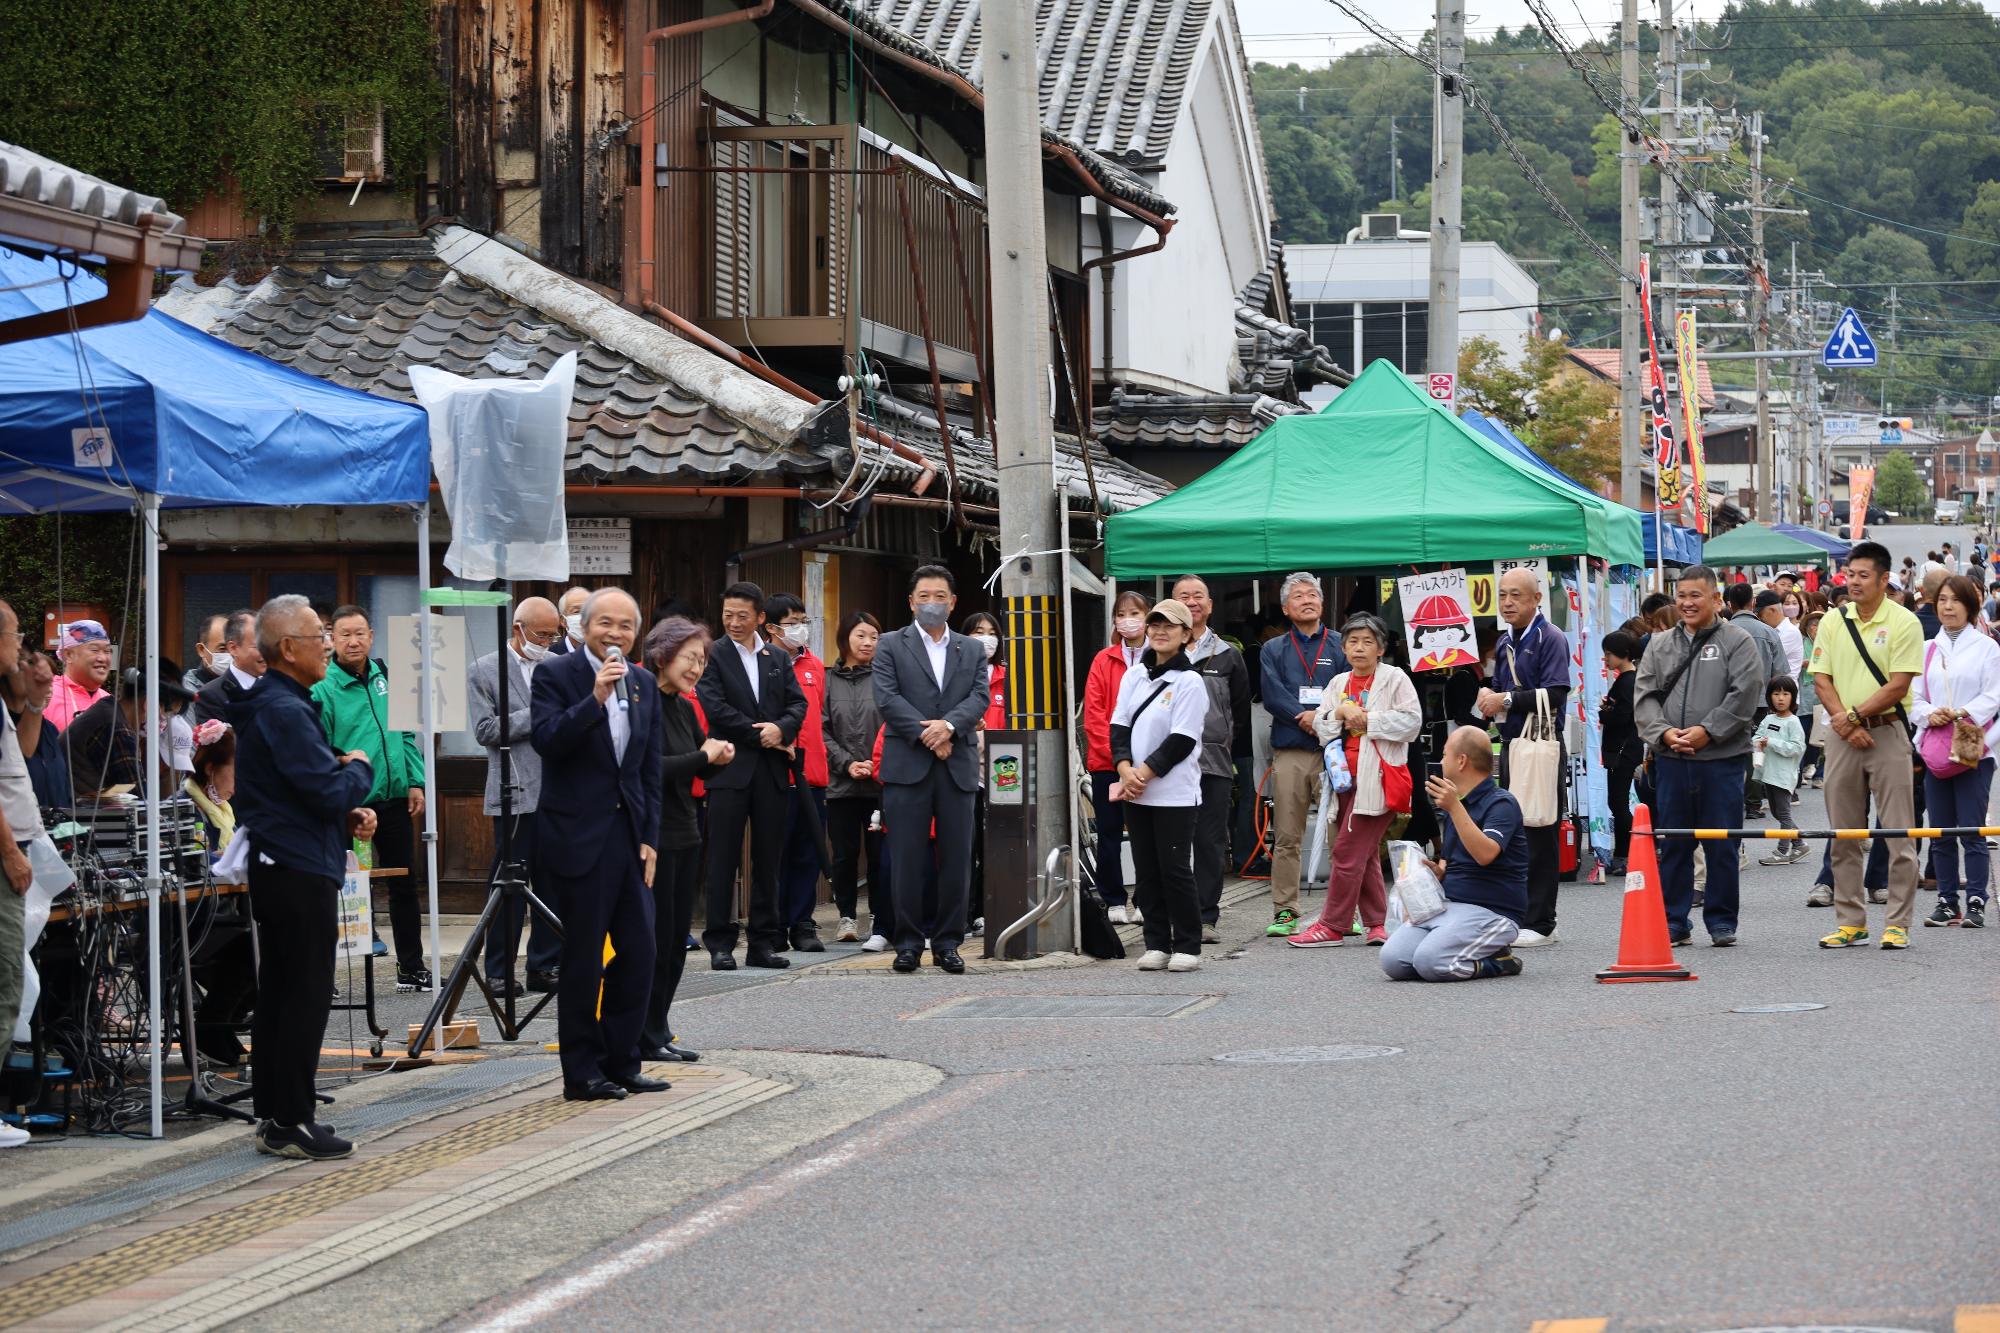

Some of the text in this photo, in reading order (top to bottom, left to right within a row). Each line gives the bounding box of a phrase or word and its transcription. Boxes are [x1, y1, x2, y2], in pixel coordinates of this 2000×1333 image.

[1403, 571, 1465, 594] ガールスカウト
